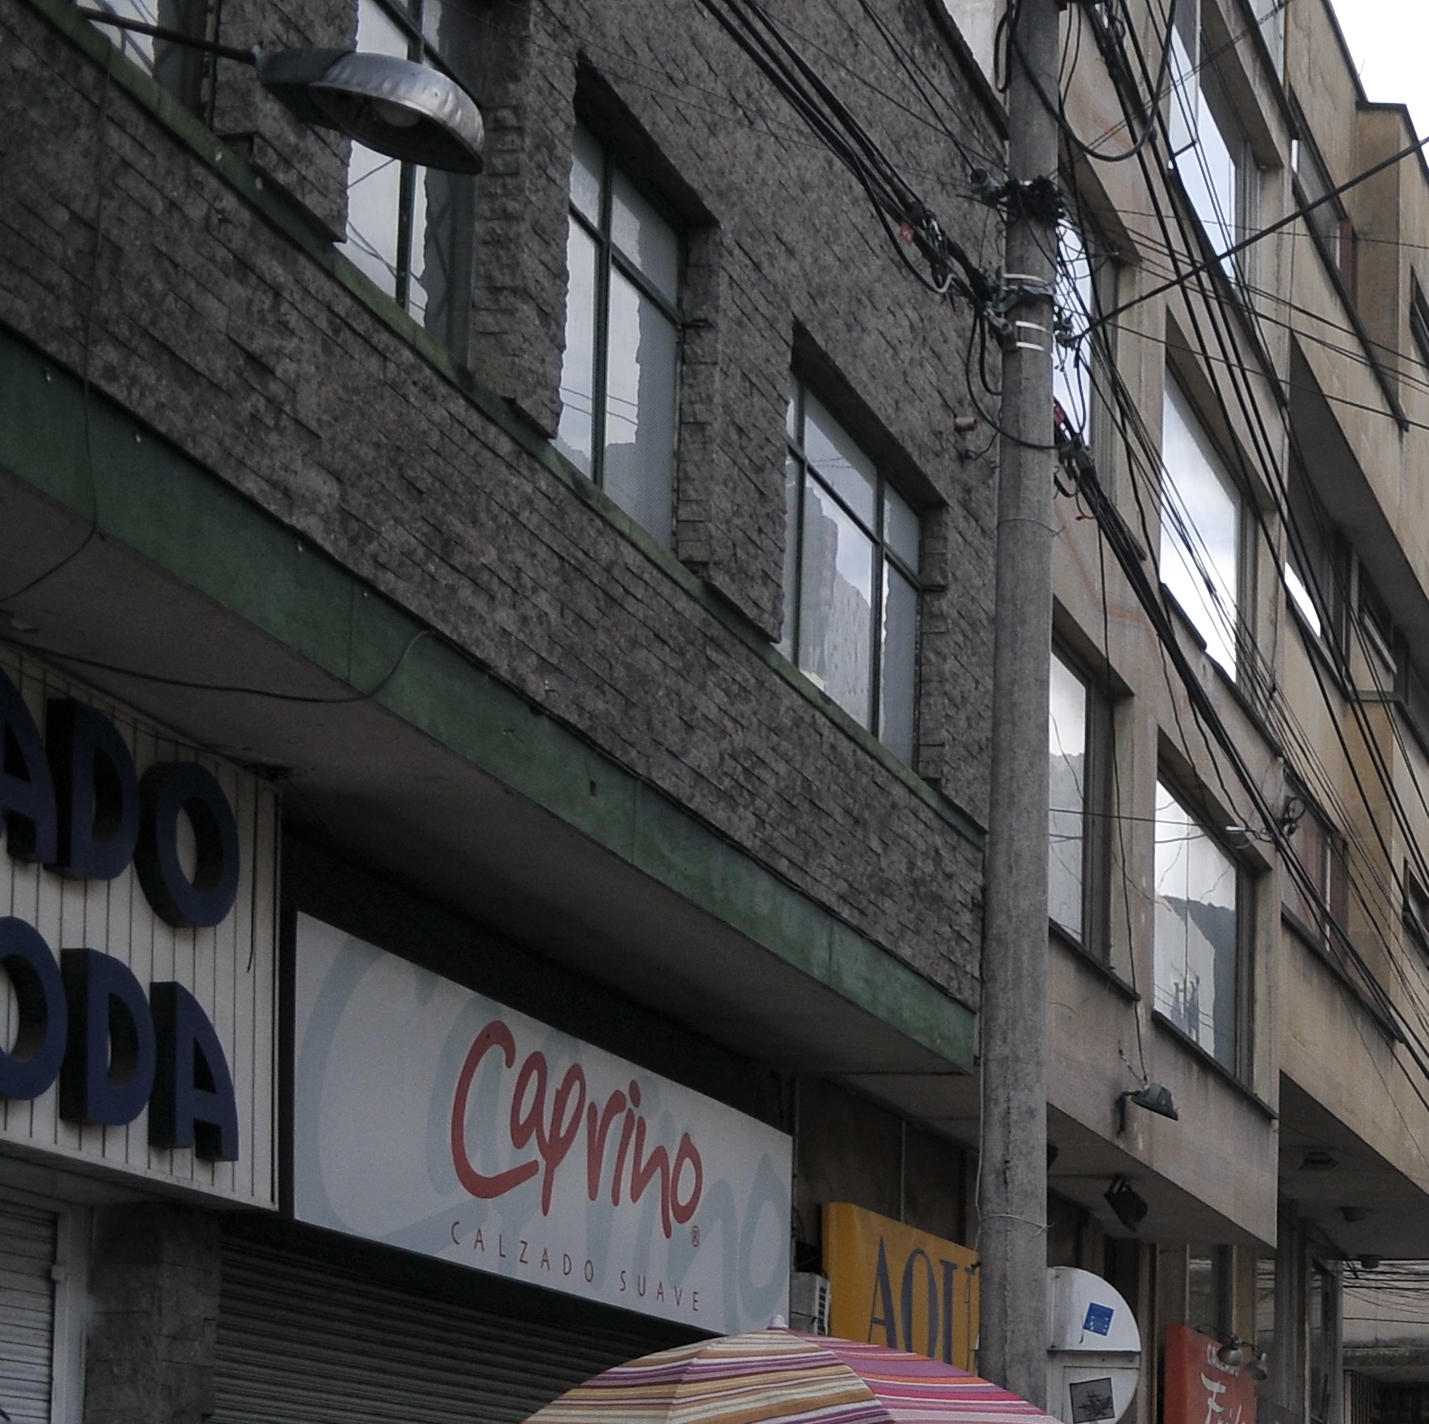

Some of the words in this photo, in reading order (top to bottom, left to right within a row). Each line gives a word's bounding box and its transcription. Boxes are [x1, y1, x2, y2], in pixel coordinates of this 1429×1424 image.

[451, 1019, 703, 1239] Caprino
[451, 1220, 595, 1283] CALZADO
[619, 1269, 700, 1312] SUAVE
